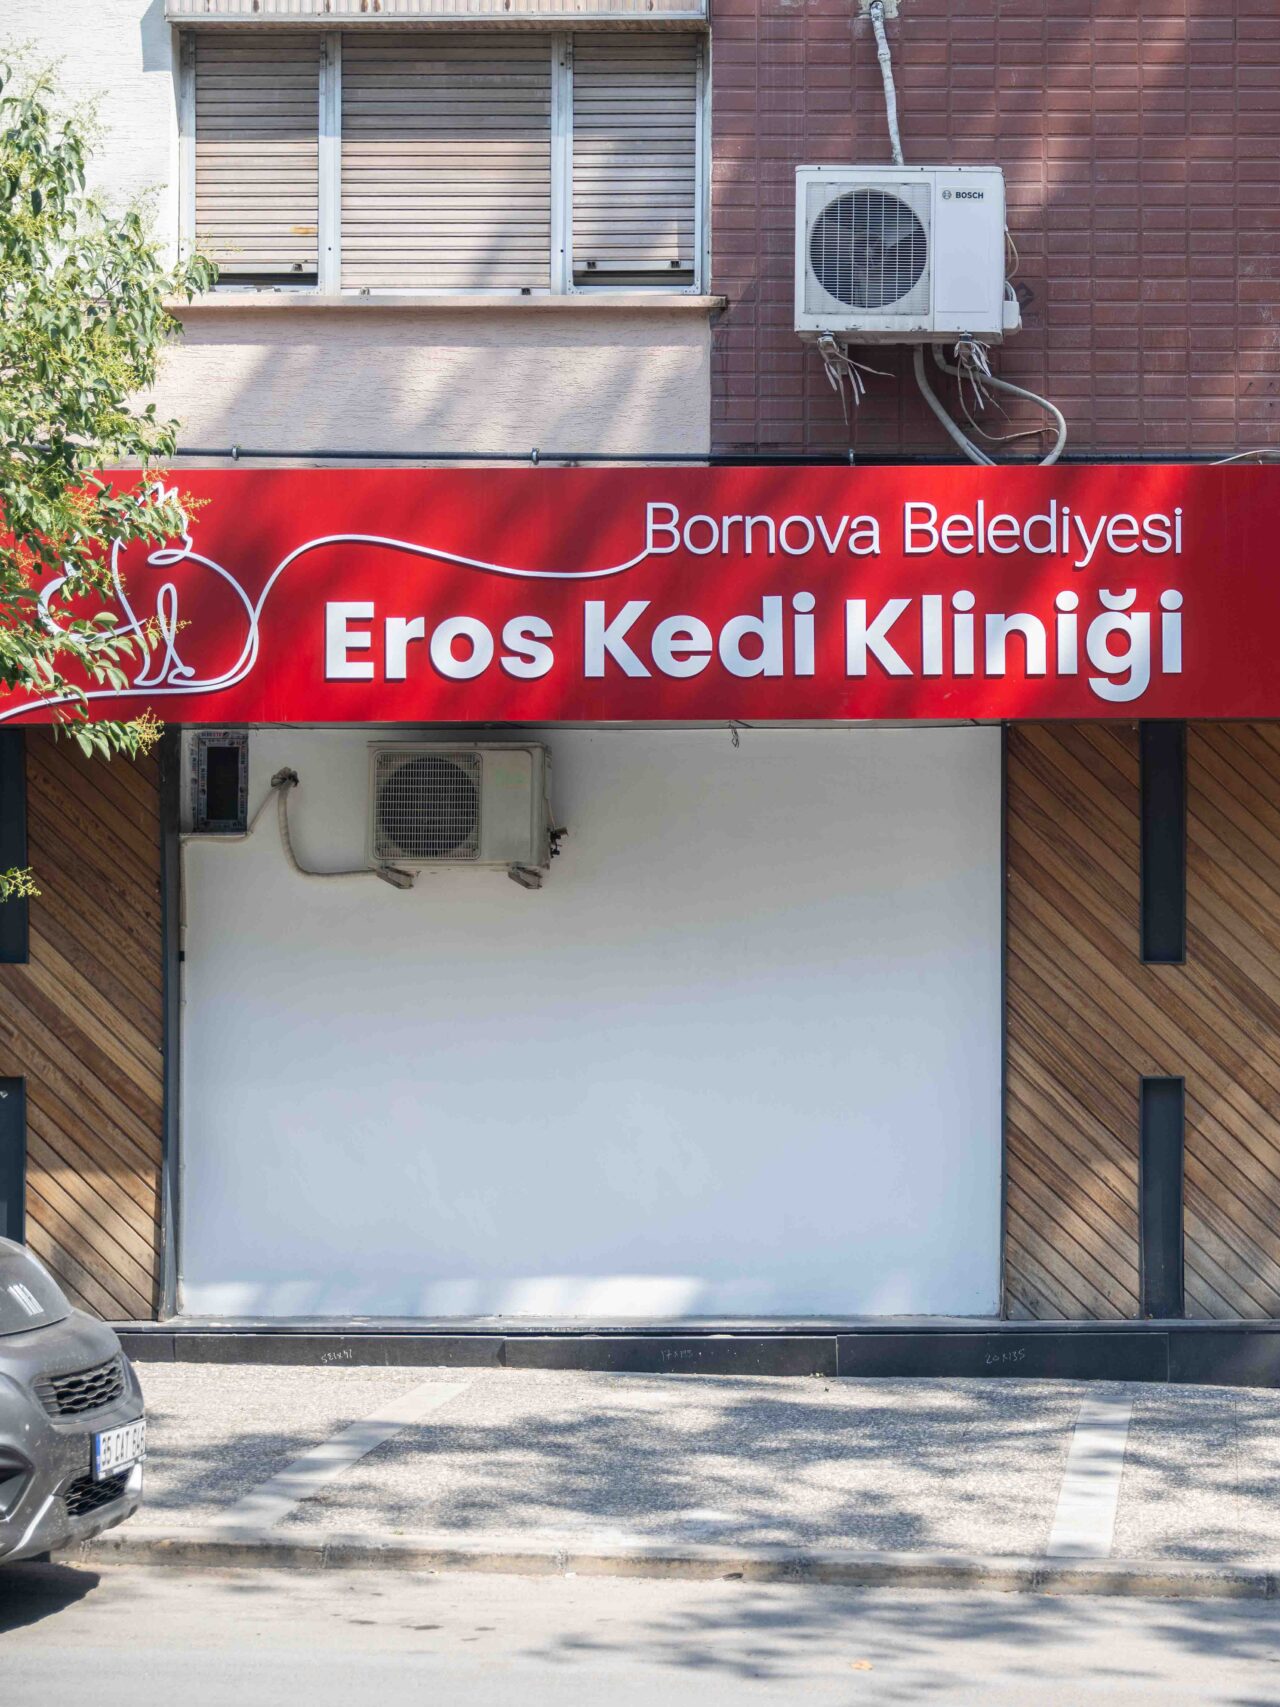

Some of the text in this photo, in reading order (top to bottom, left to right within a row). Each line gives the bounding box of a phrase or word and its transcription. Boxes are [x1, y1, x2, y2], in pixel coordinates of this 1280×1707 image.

[955, 191, 984, 199] BOSCH
[645, 499, 1183, 568] Bornova Belediyesi
[324, 588, 1183, 703] Eros Kedi Kliniği
[115, 1431, 129, 1461] CAT
